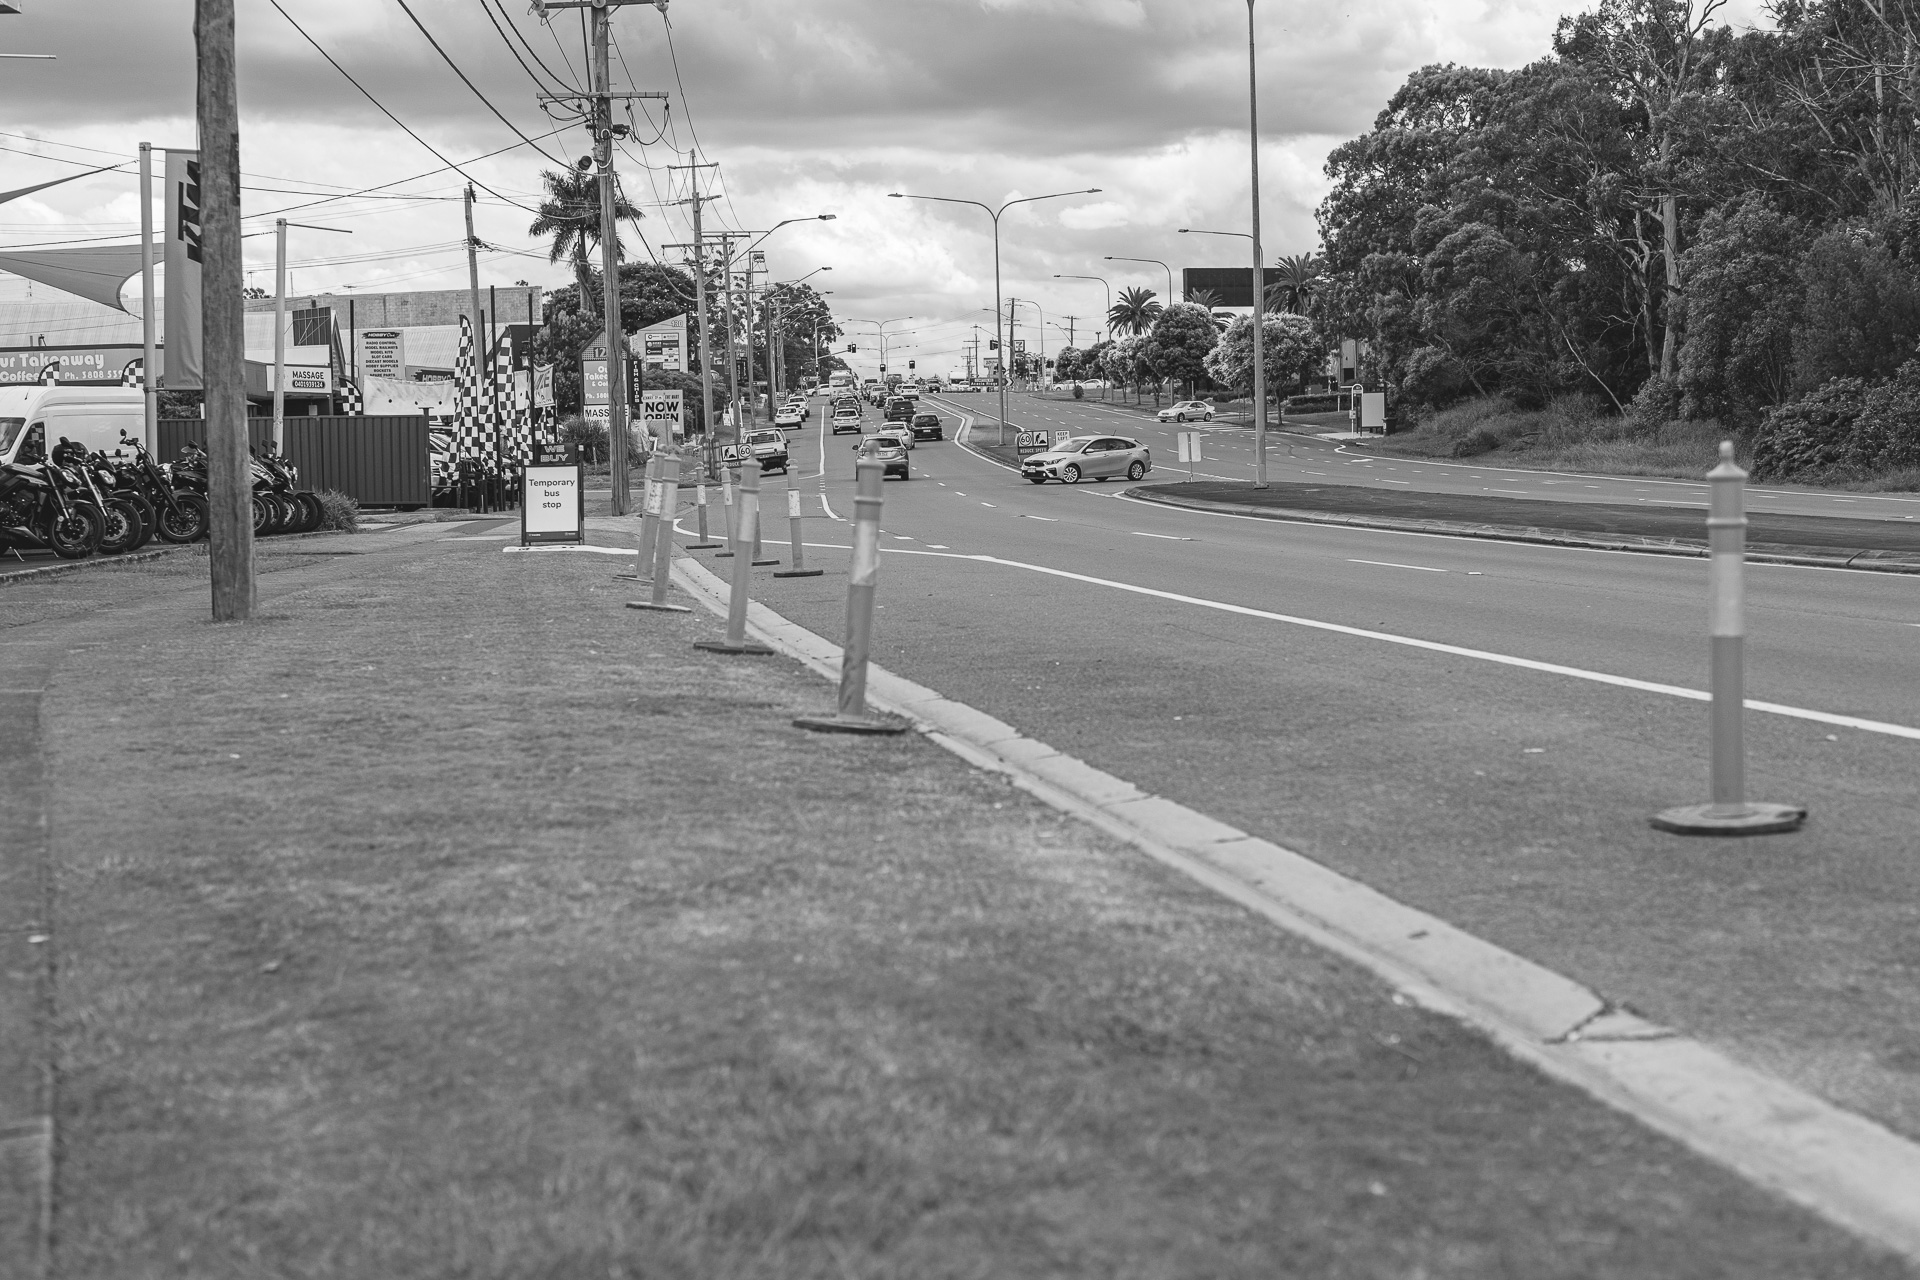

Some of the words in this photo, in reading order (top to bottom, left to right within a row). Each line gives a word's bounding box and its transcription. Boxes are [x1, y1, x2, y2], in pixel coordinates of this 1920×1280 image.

[82, 370, 104, 379] 3808
[292, 371, 324, 379] MASSAGE
[645, 402, 679, 412] NOW
[645, 413, 678, 422] OPEN
[541, 454, 568, 462] BUY
[528, 479, 575, 487] Temporary
